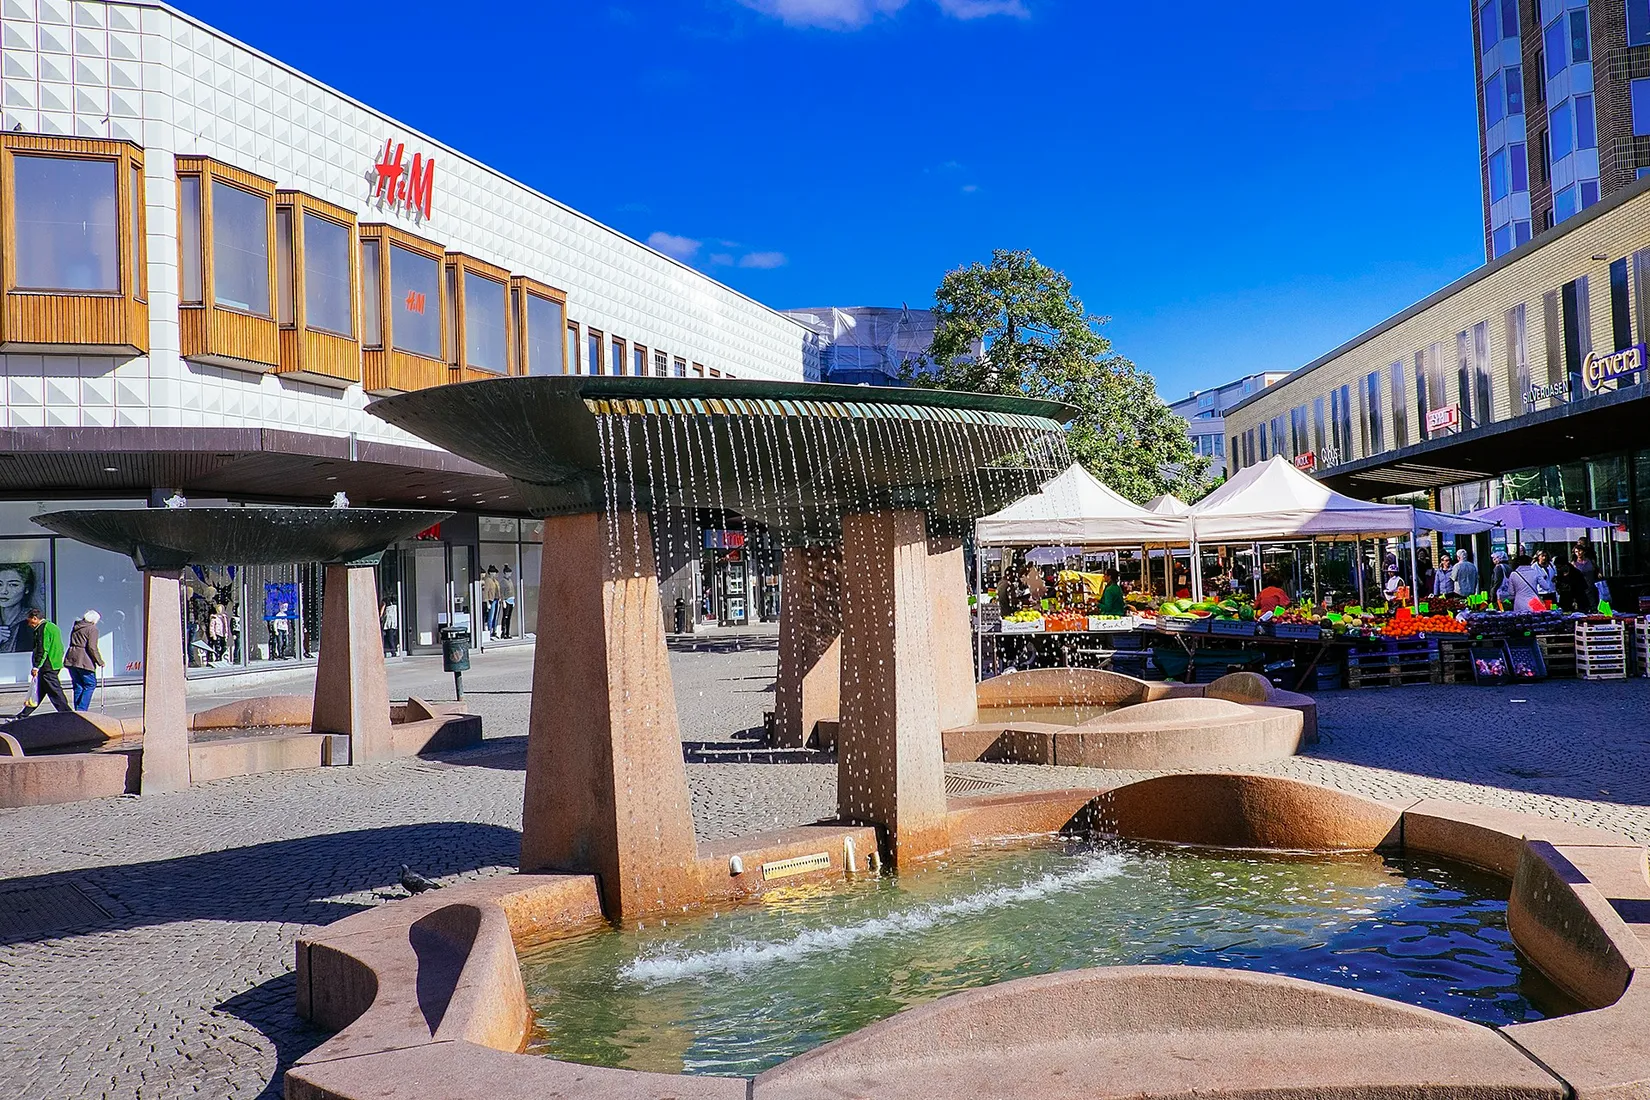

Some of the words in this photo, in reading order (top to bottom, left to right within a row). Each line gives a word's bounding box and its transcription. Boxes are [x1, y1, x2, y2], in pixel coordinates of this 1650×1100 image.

[375, 138, 435, 221] H&M
[405, 290, 426, 315] H&M
[1582, 348, 1642, 392] Cervera
[1522, 380, 1569, 403] SILVEROASEN
